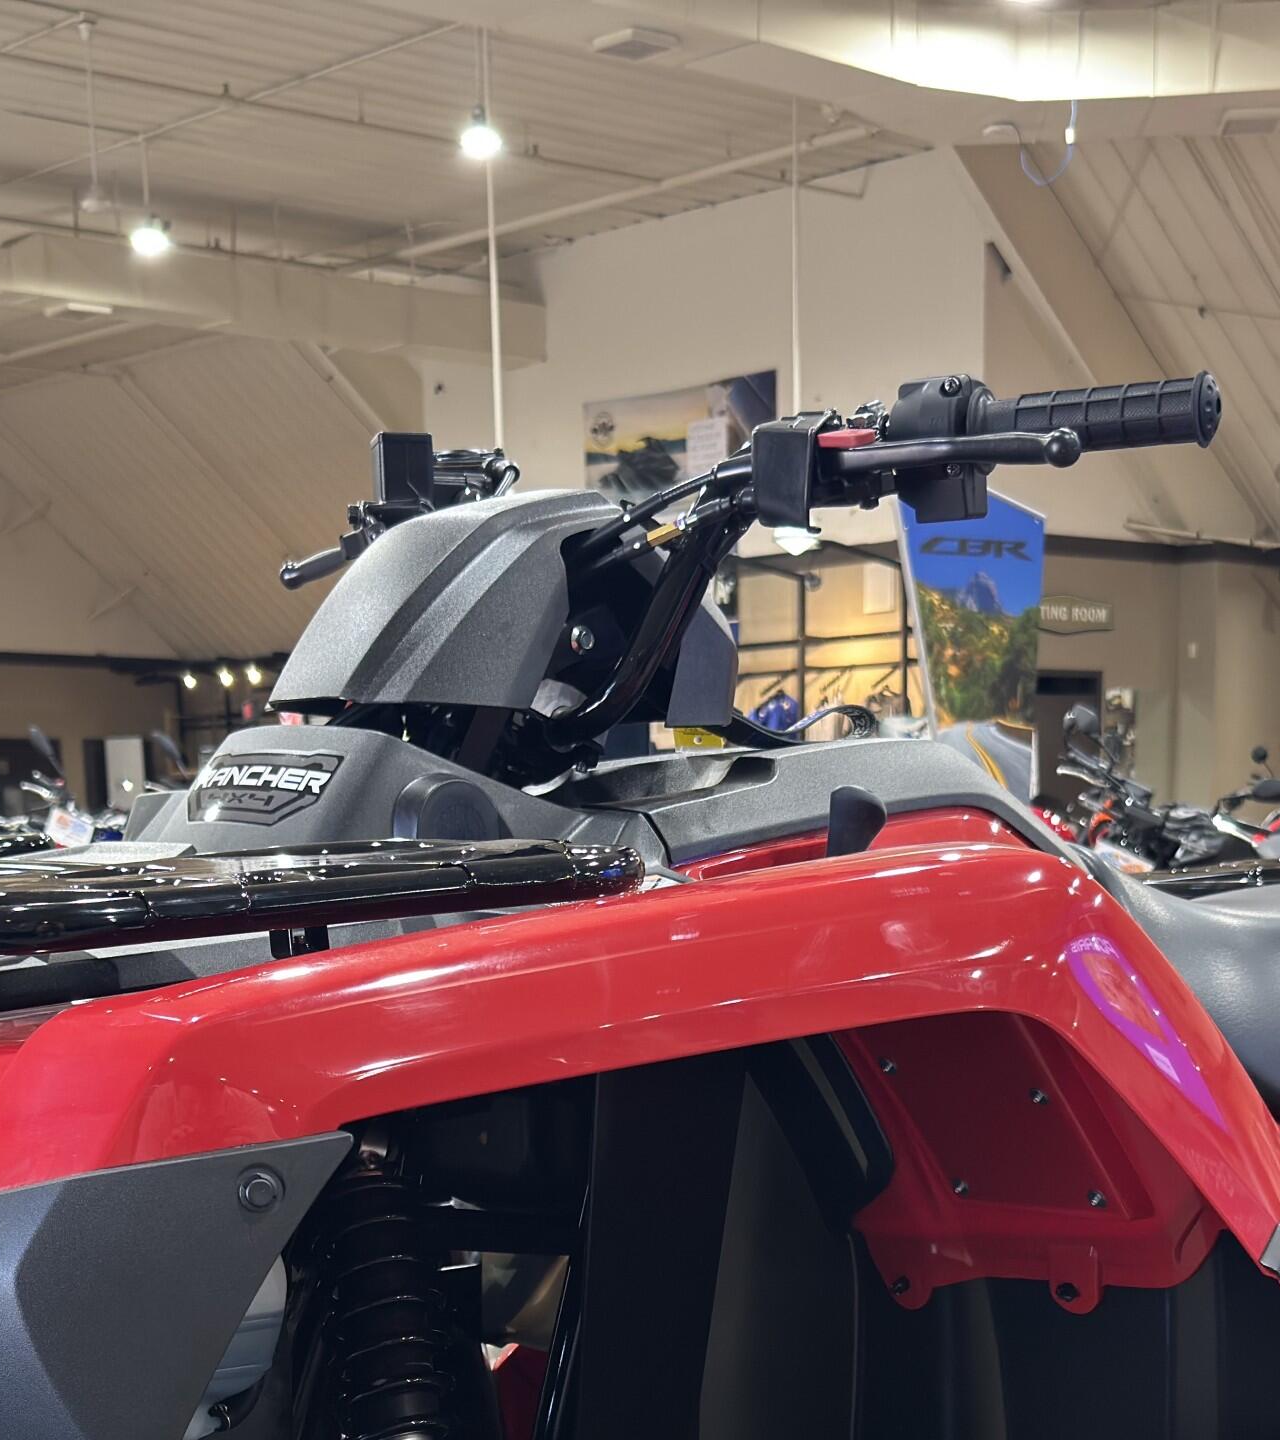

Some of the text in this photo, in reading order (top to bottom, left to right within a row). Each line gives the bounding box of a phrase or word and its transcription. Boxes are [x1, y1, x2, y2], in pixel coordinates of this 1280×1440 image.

[918, 536, 1032, 562] CBR
[1071, 606, 1107, 623] ROOM
[193, 764, 332, 794] RANCHER
